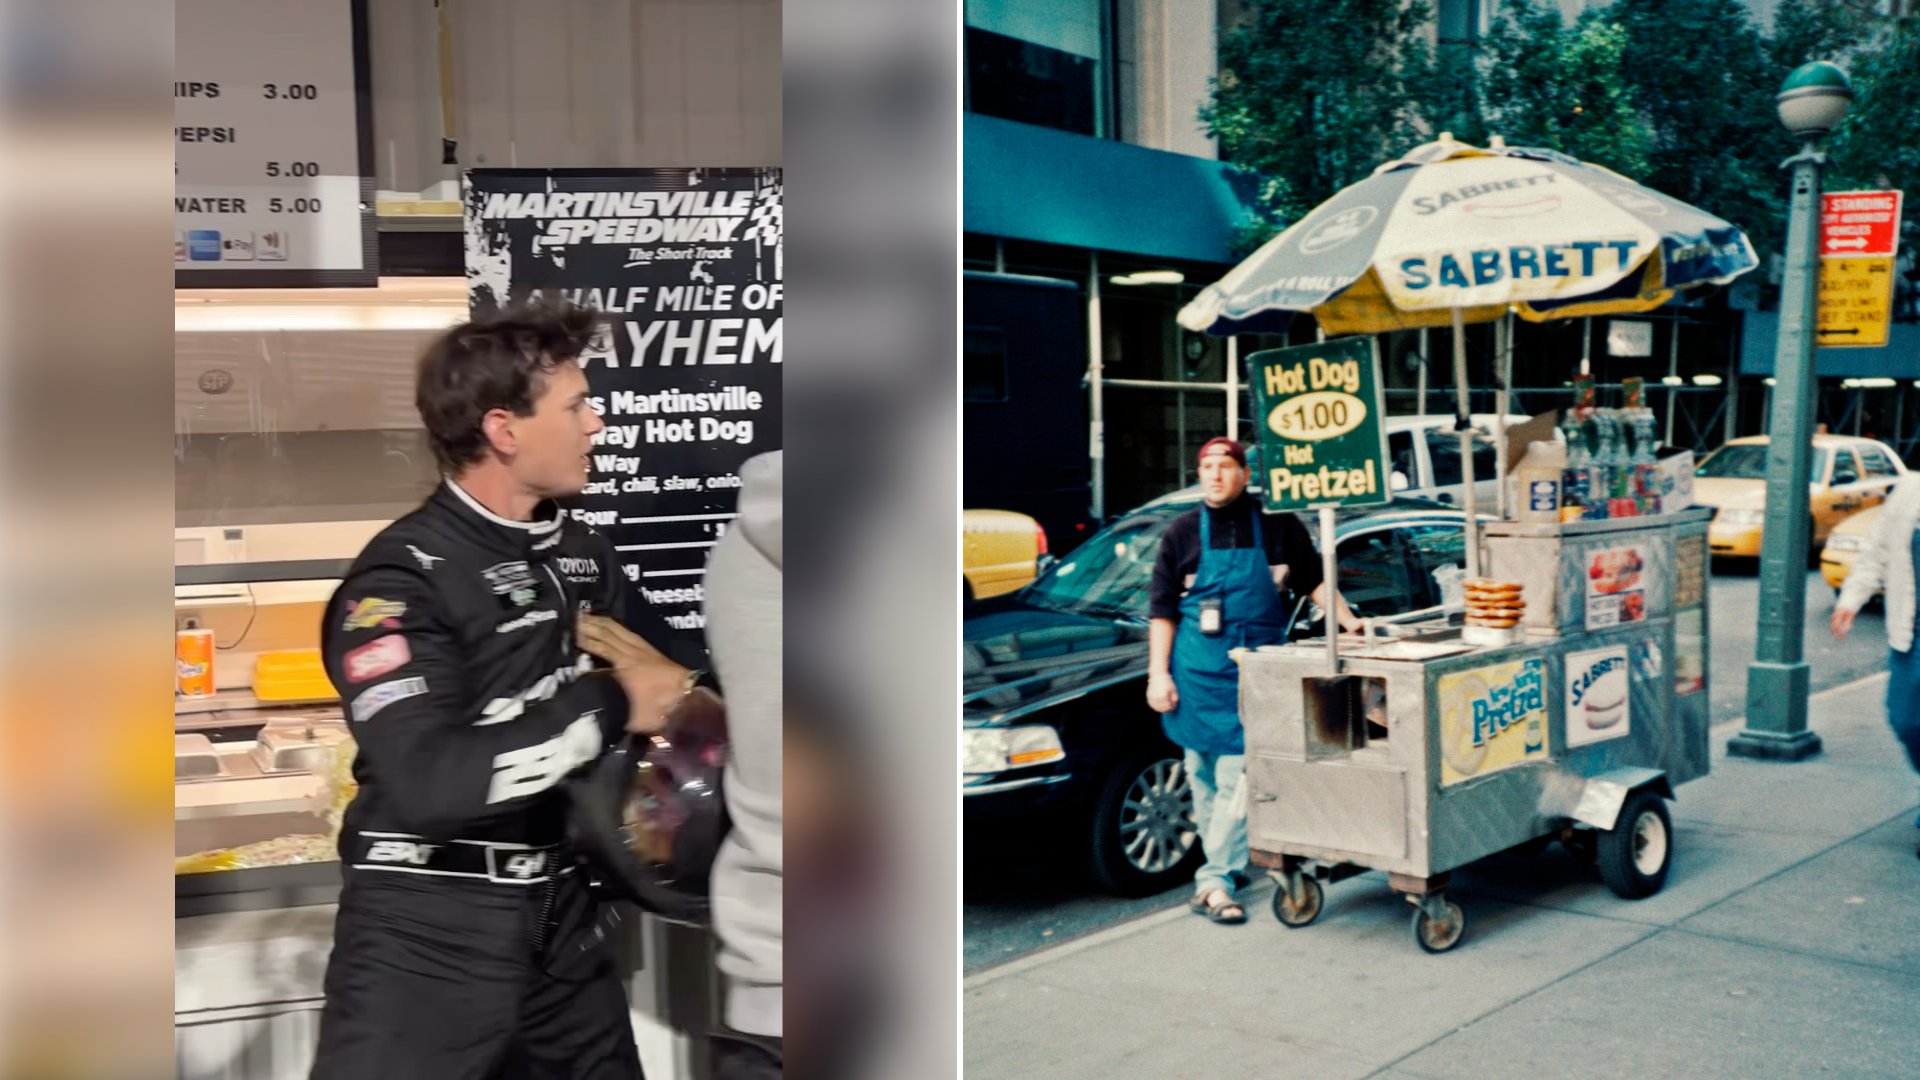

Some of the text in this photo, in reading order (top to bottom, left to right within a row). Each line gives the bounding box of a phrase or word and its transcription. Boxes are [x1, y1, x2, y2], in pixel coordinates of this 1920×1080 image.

[263, 83, 317, 100] 3.00
[175, 126, 235, 143] EPSI
[266, 162, 319, 177] 5.00
[270, 198, 321, 213] 5.00
[482, 190, 754, 219] MARTINSVILLE
[1412, 171, 1557, 216] SABRETT
[539, 217, 745, 245] SPEEDWAY
[628, 246, 733, 262] The Short Track
[1400, 240, 1638, 290] SABRETT
[655, 284, 735, 312] MILE
[742, 283, 782, 311] OF
[577, 317, 782, 369] AYHEM
[1264, 357, 1360, 396] Hot Dog
[611, 386, 763, 415] Martinsville
[1281, 400, 1348, 432] $1.00
[590, 417, 754, 449] way Hot Dog
[593, 454, 641, 474] Way
[1283, 443, 1314, 466] Hot
[581, 478, 619, 496] ard,
[663, 475, 703, 492] slaw,
[706, 473, 744, 489] onio
[1270, 459, 1377, 502] Pretzel
[1571, 655, 1626, 707] SABRETT
